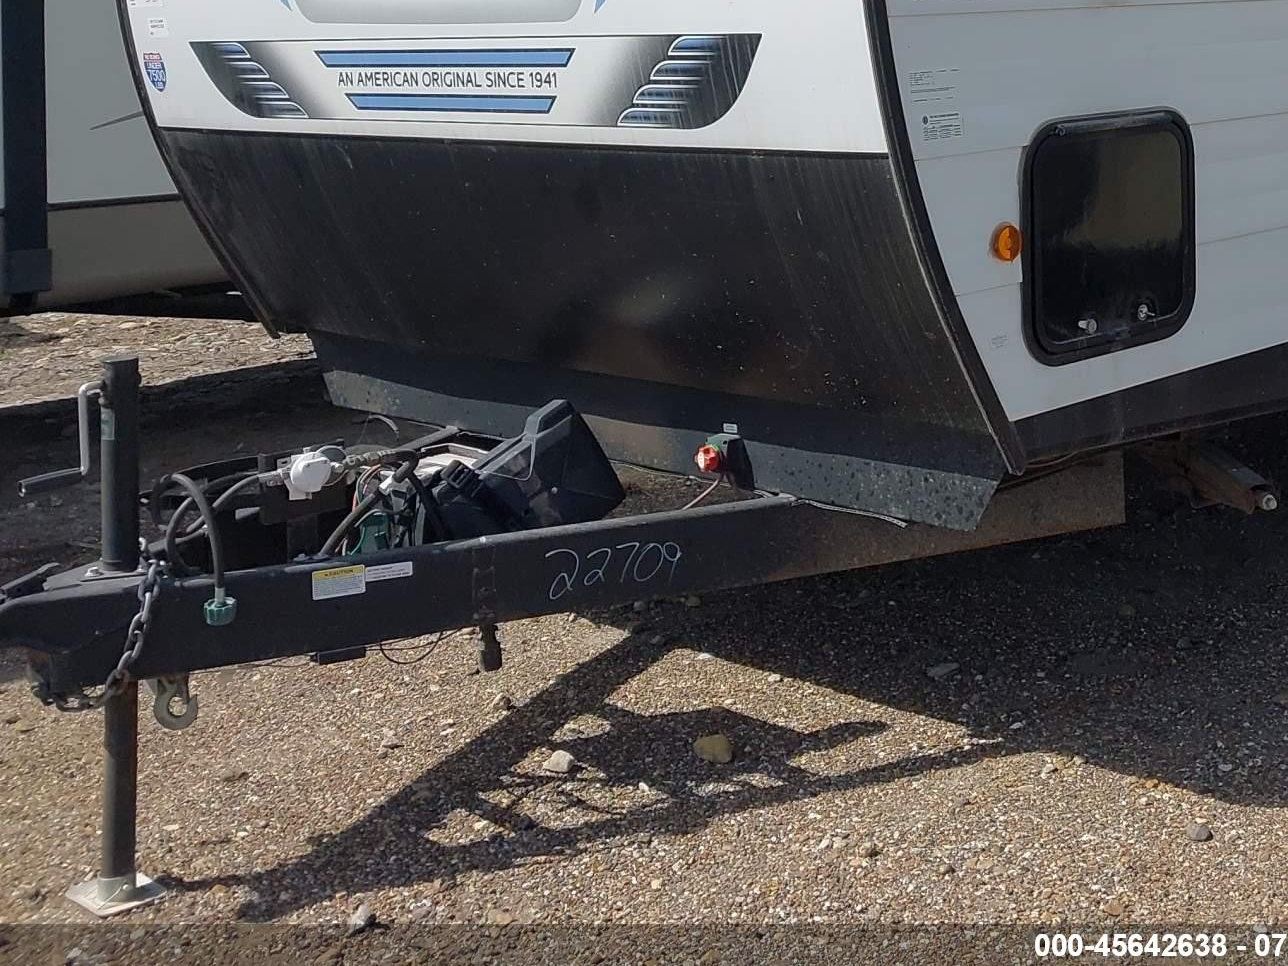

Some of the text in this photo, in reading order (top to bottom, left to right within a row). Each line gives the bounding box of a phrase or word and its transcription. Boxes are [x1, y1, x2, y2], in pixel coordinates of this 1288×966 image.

[148, 70, 166, 82] 7500
[337, 71, 558, 89] AN AMERICAN ORIGINAL SINCE 1941
[545, 541, 682, 600] 22709
